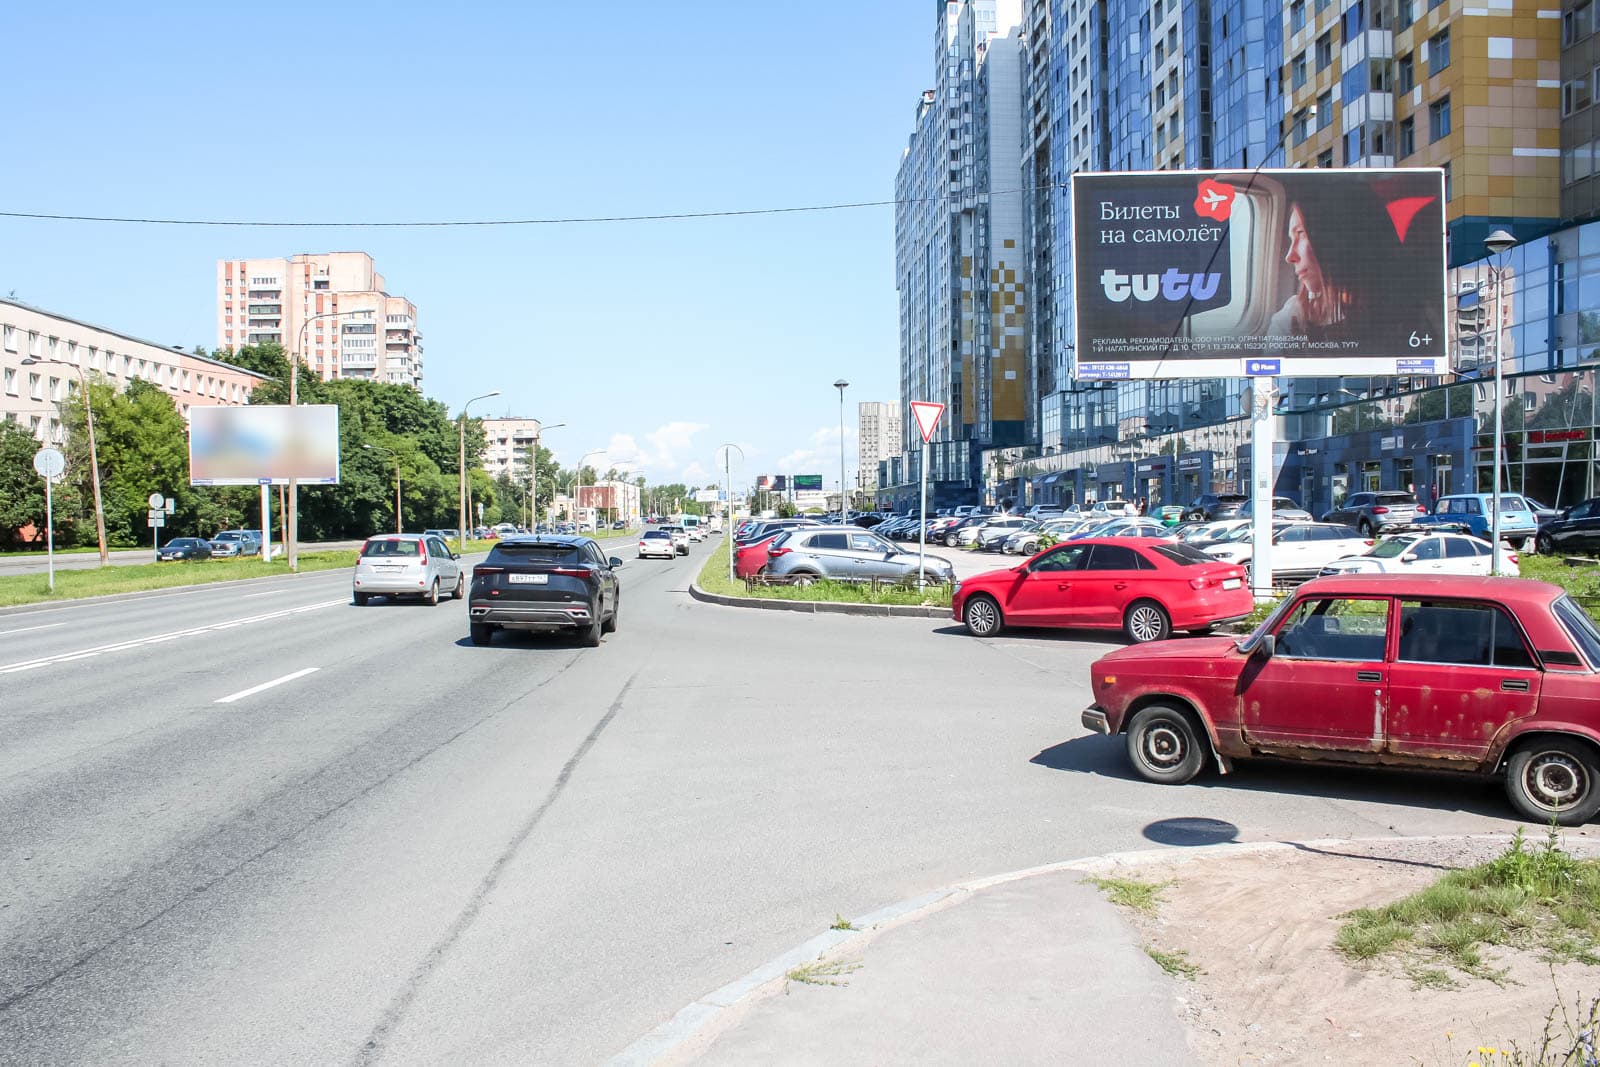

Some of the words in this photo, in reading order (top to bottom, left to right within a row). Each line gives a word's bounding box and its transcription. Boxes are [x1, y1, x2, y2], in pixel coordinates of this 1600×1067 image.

[1099, 200, 1180, 221] Билеты
[1100, 229, 1126, 244] на
[1132, 224, 1222, 244] самолёт
[1100, 267, 1222, 302] tutu
[1105, 344, 1158, 352] НАГАТИНСКИЙ
[1408, 330, 1433, 348] 6+
